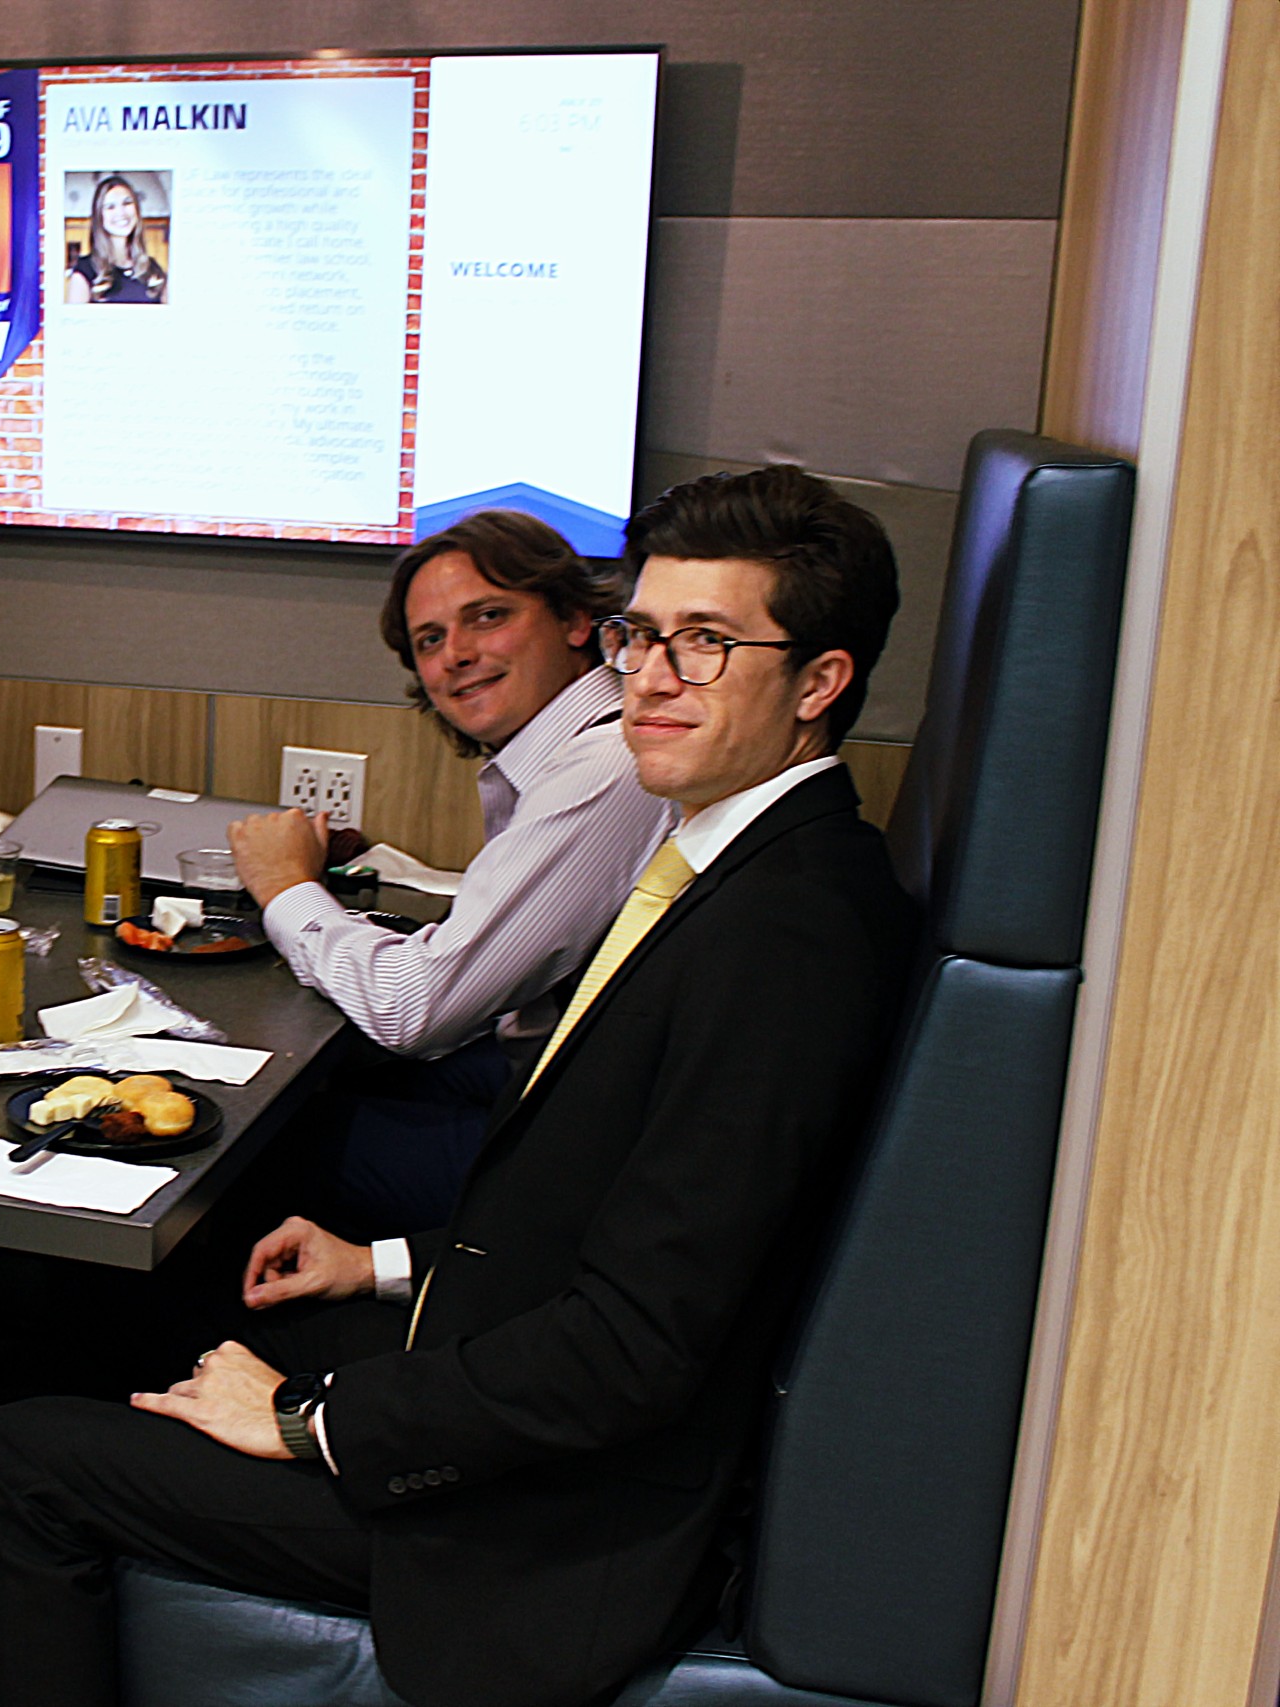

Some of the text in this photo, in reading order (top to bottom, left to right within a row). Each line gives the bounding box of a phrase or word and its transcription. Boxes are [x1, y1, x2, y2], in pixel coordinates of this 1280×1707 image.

[63, 103, 247, 132] AVA MALKIN
[233, 168, 308, 184] represents
[311, 168, 336, 181] the
[242, 184, 329, 200] professional
[332, 185, 363, 198] and
[249, 203, 296, 218] growth
[310, 219, 360, 234] quality
[295, 235, 318, 248] call
[322, 235, 365, 248] home
[450, 260, 559, 279] WELCOME
[345, 304, 366, 316] on
[311, 352, 337, 365] the
[303, 401, 338, 414] work
[316, 418, 375, 433] ultimate
[308, 436, 385, 453] advocating
